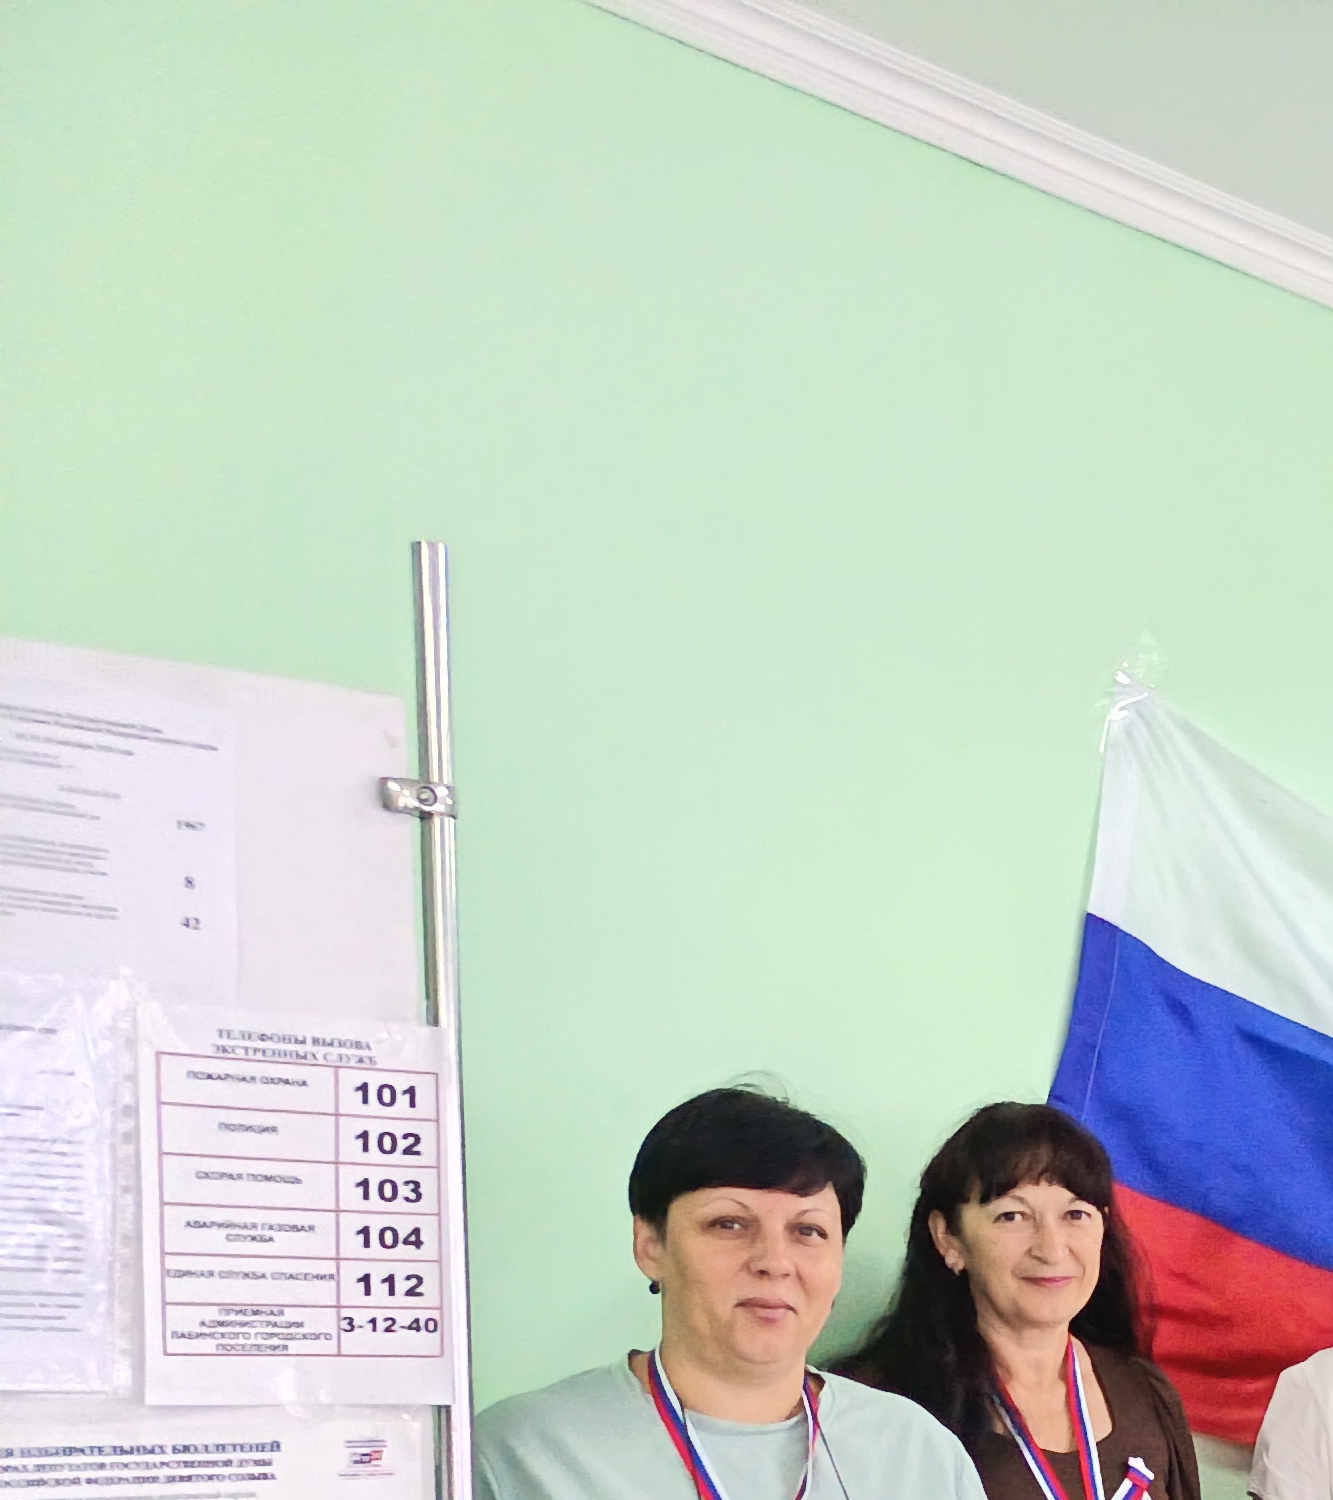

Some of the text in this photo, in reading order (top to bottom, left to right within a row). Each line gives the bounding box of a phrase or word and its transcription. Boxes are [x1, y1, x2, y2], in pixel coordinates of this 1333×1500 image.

[217, 1029, 372, 1052] ТЕЛЕФОНЫ ВЫЗОВА
[211, 1043, 377, 1067] ЭКСТРЕННЫХ СЛУЖБ
[355, 1081, 417, 1108] 101
[355, 1130, 422, 1156] 102
[355, 1177, 423, 1203] 103
[356, 1226, 424, 1250] 104
[356, 1273, 424, 1297] 112
[341, 1316, 438, 1333] 3-12-40
